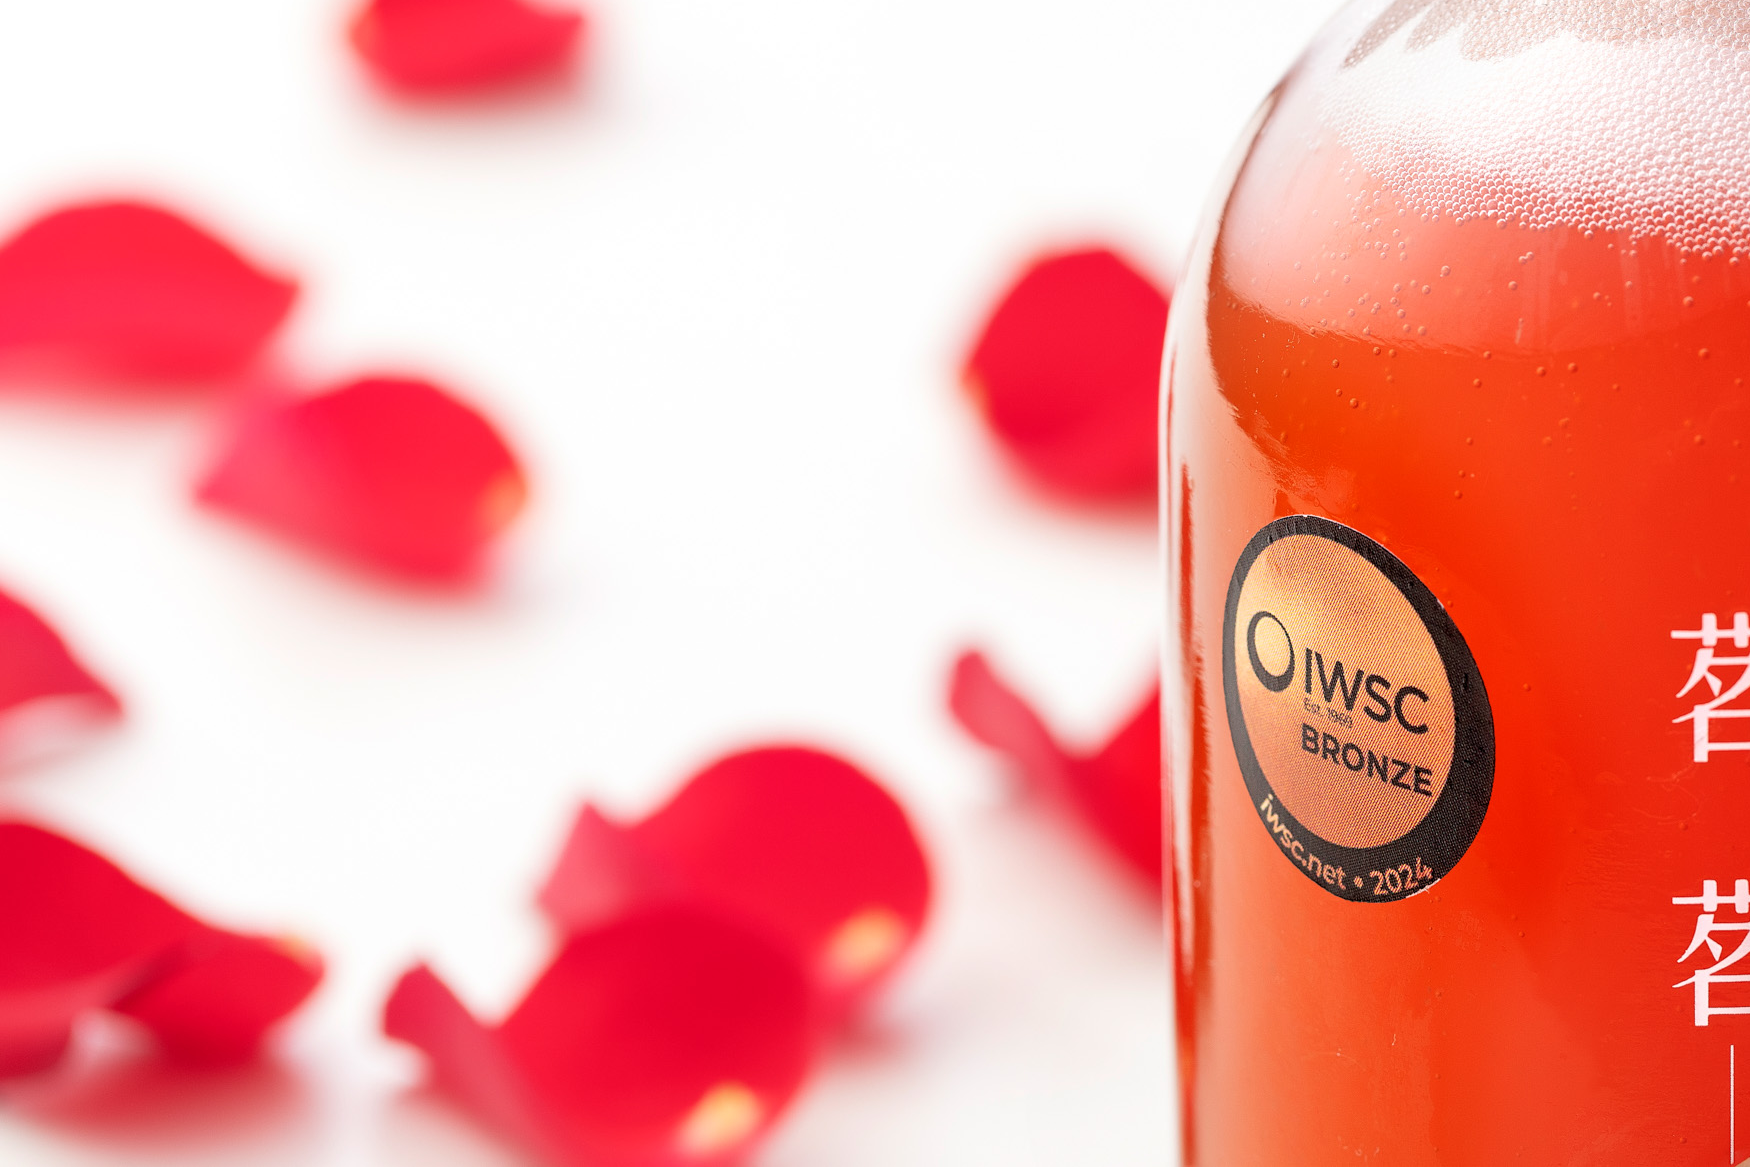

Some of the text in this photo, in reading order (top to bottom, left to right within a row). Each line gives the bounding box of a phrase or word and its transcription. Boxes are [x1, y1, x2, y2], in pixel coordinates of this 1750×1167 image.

[1305, 646, 1430, 735] IWSC
[1300, 722, 1434, 797] BRONZE
[1259, 793, 1434, 896] iwsc.net 2024
